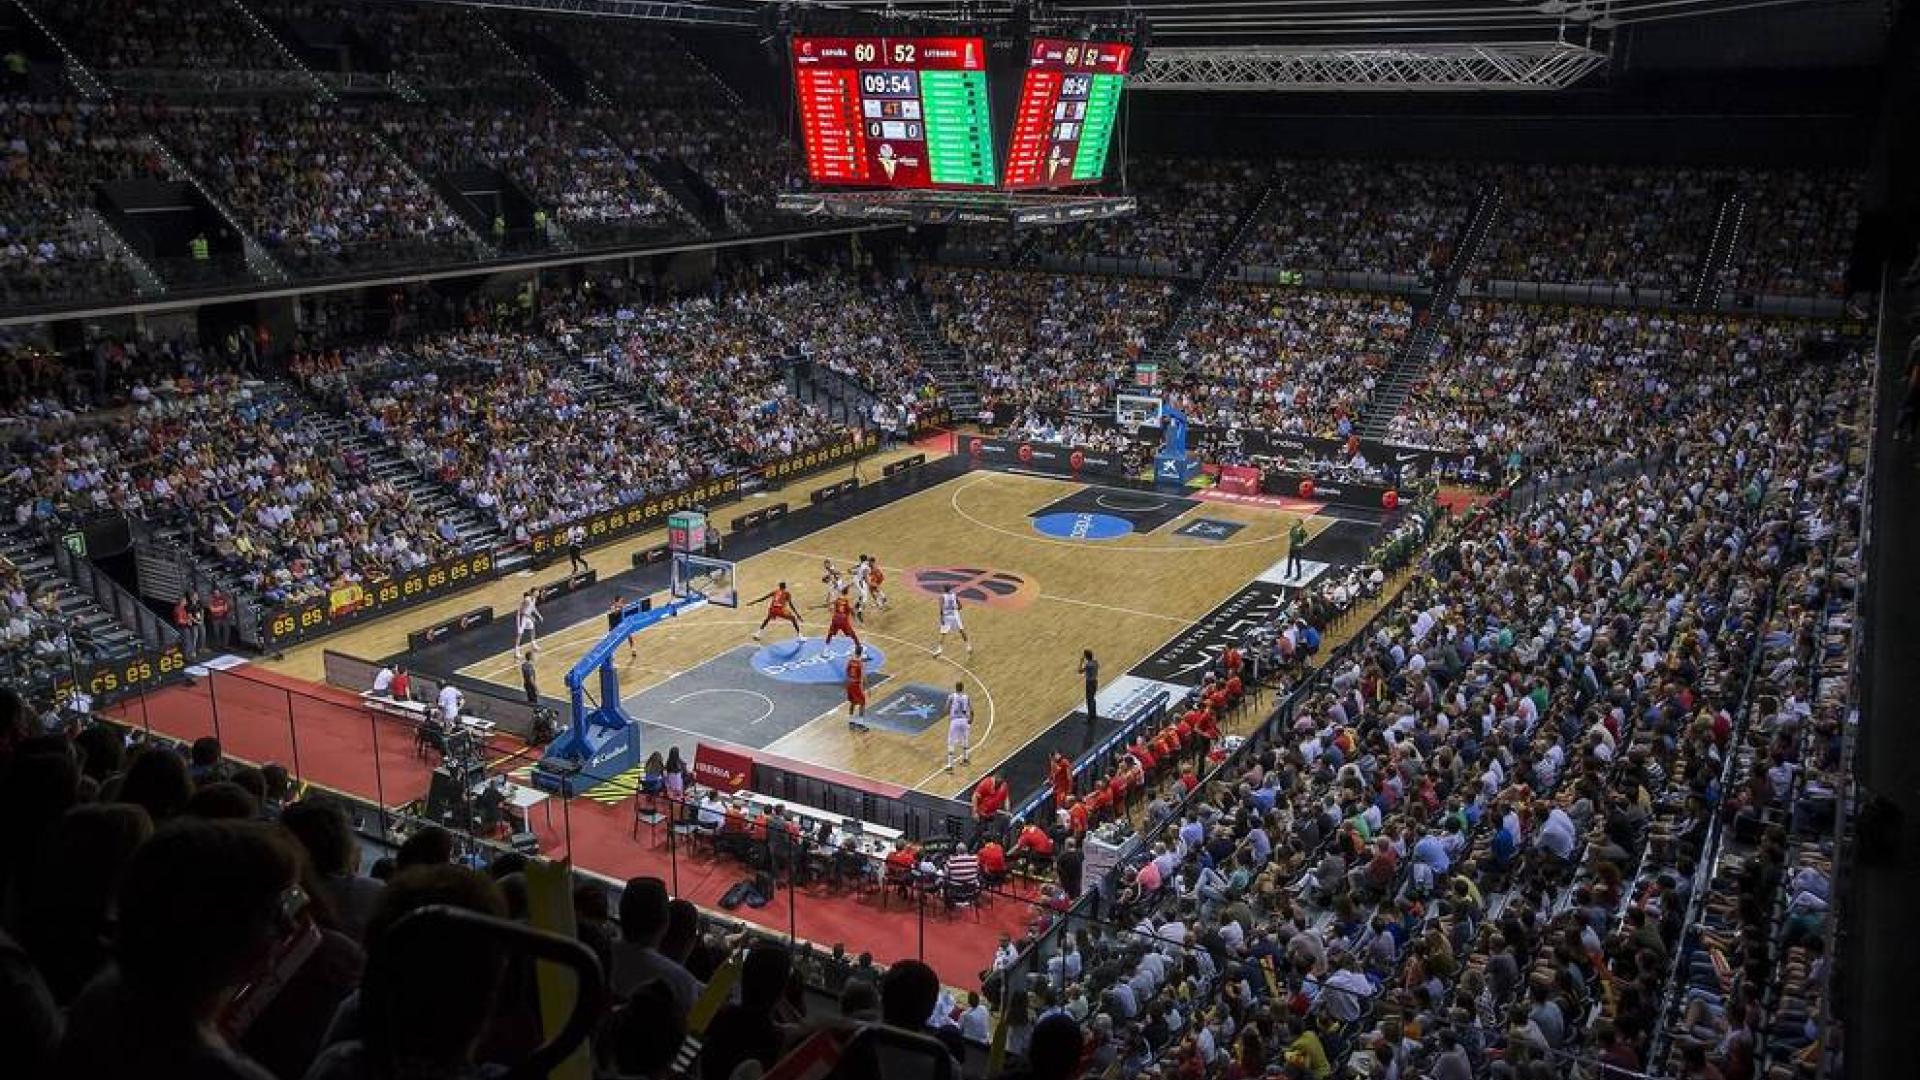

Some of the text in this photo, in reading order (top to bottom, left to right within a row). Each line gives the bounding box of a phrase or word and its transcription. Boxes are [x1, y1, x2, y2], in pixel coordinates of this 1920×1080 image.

[854, 44, 875, 62] 60
[894, 44, 915, 62] 52
[864, 75, 911, 93] 09:54
[872, 123, 916, 137] 0 0
[273, 616, 296, 635] es
[302, 608, 323, 627] es
[380, 585, 398, 602] es
[404, 578, 422, 595] es
[428, 570, 445, 587] es
[451, 563, 468, 580] es
[472, 557, 490, 573] es
[126, 663, 152, 684] es
[159, 652, 185, 673] es
[695, 762, 731, 779] IBERIA
